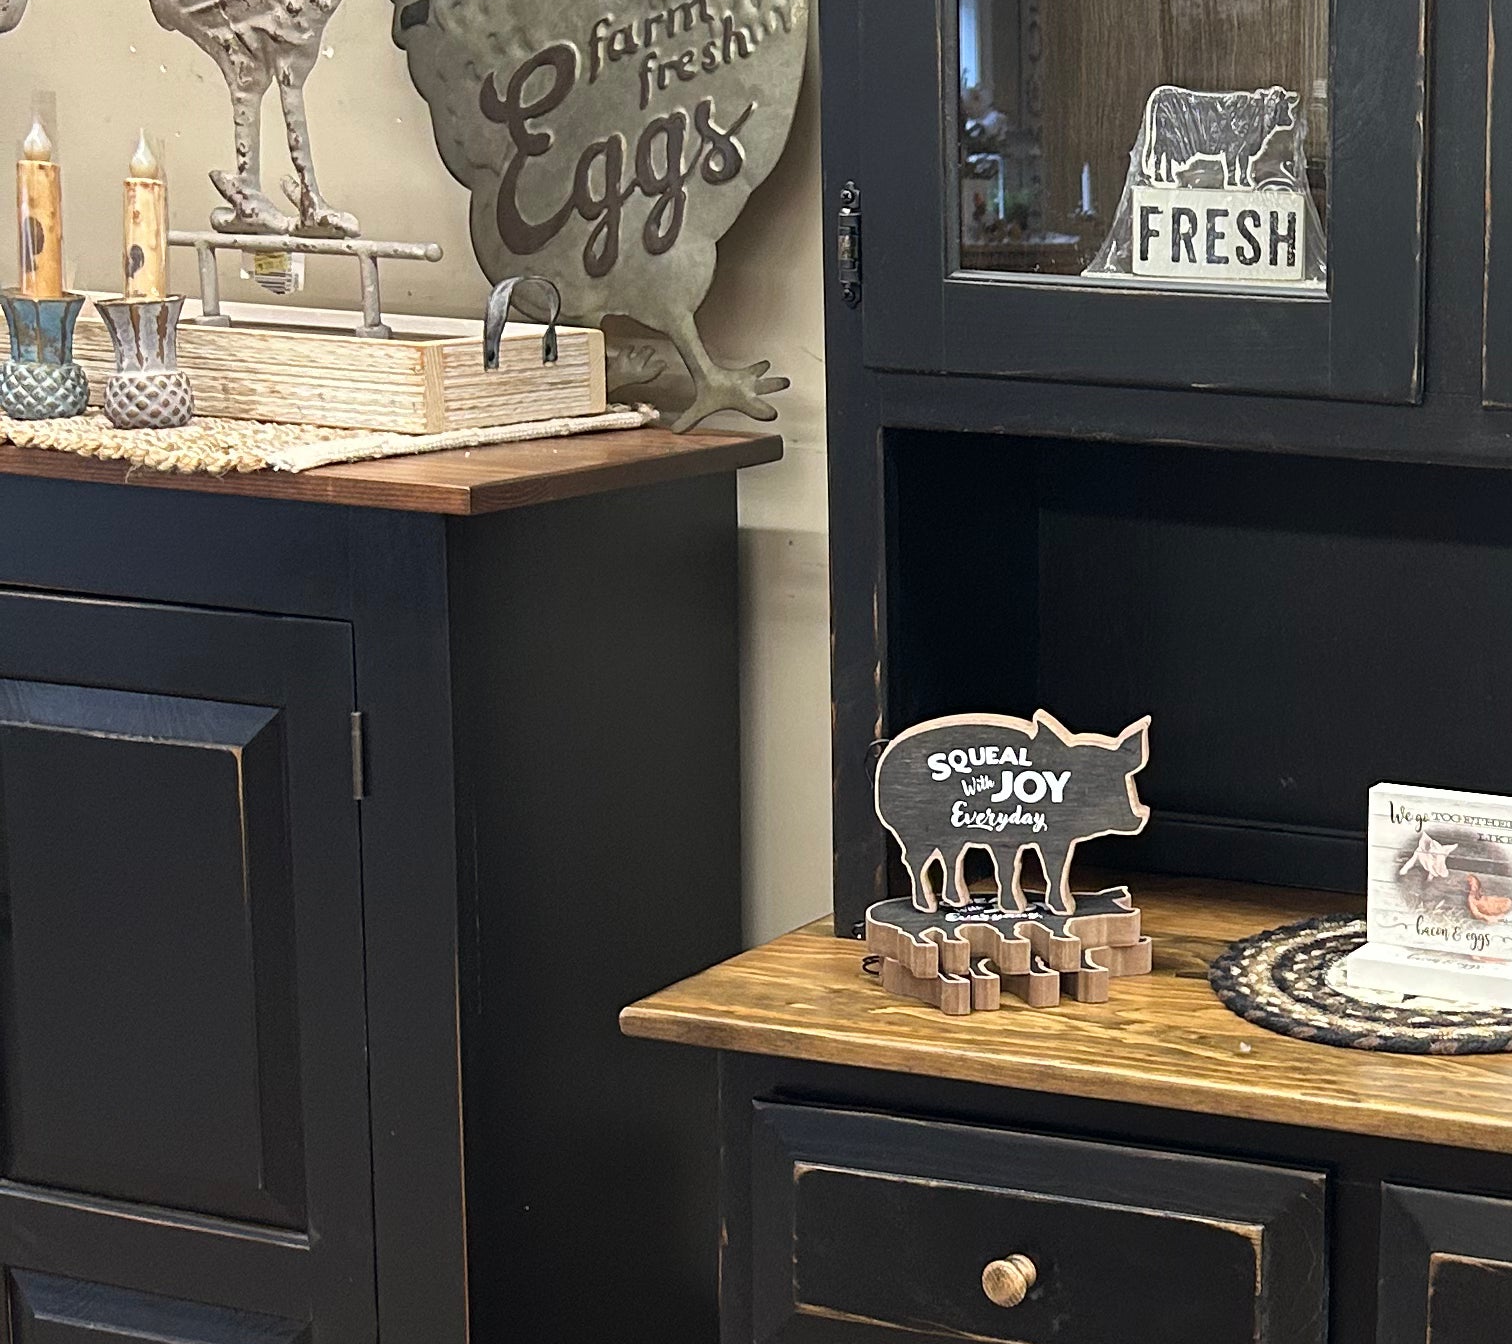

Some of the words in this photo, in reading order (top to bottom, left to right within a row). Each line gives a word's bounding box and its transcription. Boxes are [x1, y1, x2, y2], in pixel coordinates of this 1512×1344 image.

[640, 11, 752, 110] fresh
[479, 42, 755, 278] Eggs
[1139, 206, 1296, 267] FRESH
[927, 746, 1033, 781] SQUEAL
[961, 774, 995, 796] With
[990, 770, 1072, 803] JOY
[950, 800, 1048, 833] Everyday
[1389, 801, 1413, 824] We
[1415, 813, 1429, 832] go
[1452, 926, 1463, 942] &
[1466, 933, 1490, 951] eggs
